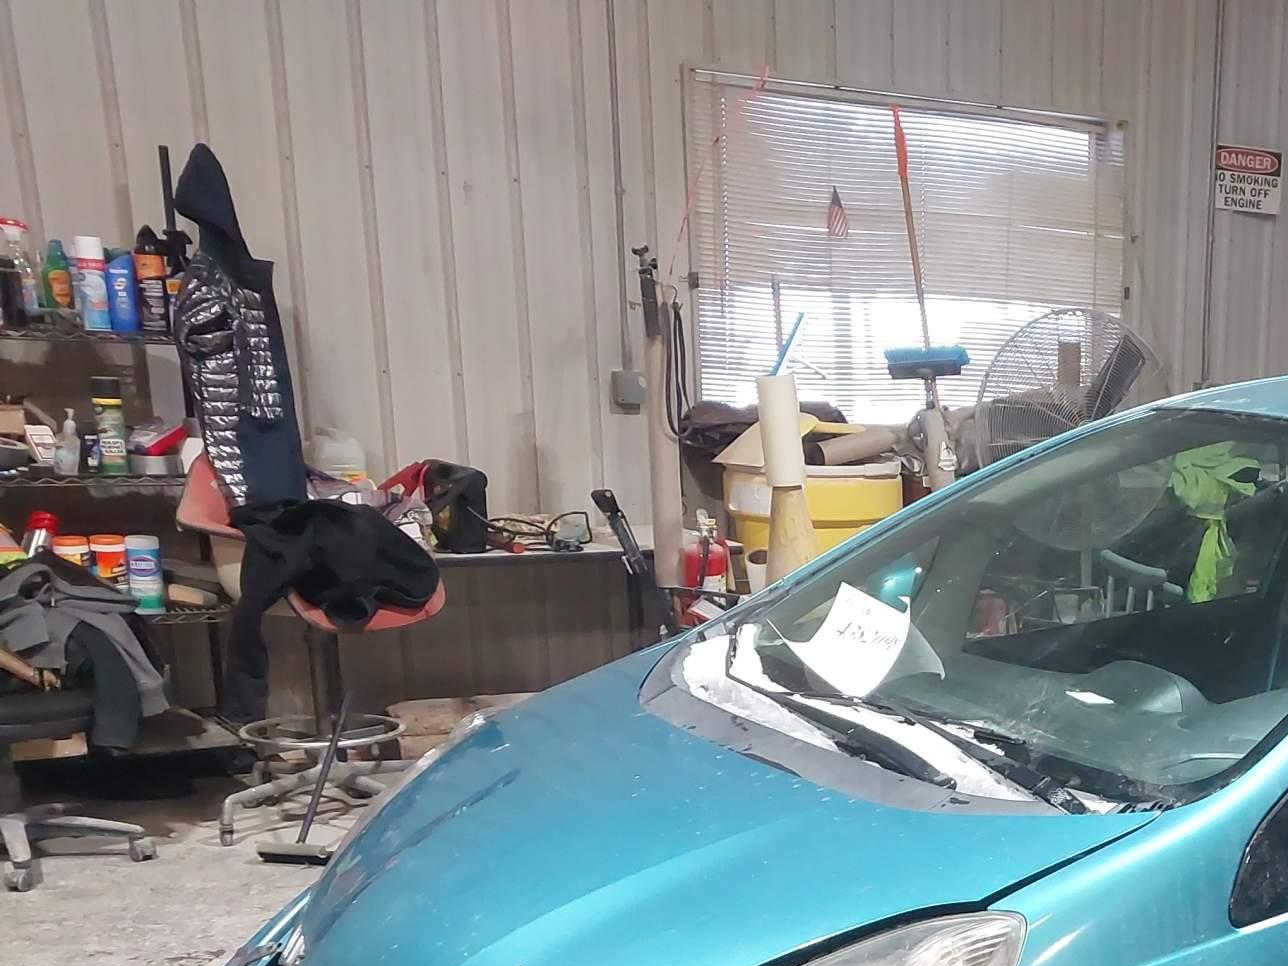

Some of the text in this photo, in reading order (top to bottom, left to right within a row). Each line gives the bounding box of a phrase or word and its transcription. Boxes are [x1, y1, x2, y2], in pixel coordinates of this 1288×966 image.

[1220, 151, 1272, 169] DANGER
[1230, 173, 1279, 188] SMOKING
[1218, 183, 1270, 199] TURN OFF
[1224, 196, 1263, 209] ENGINE
